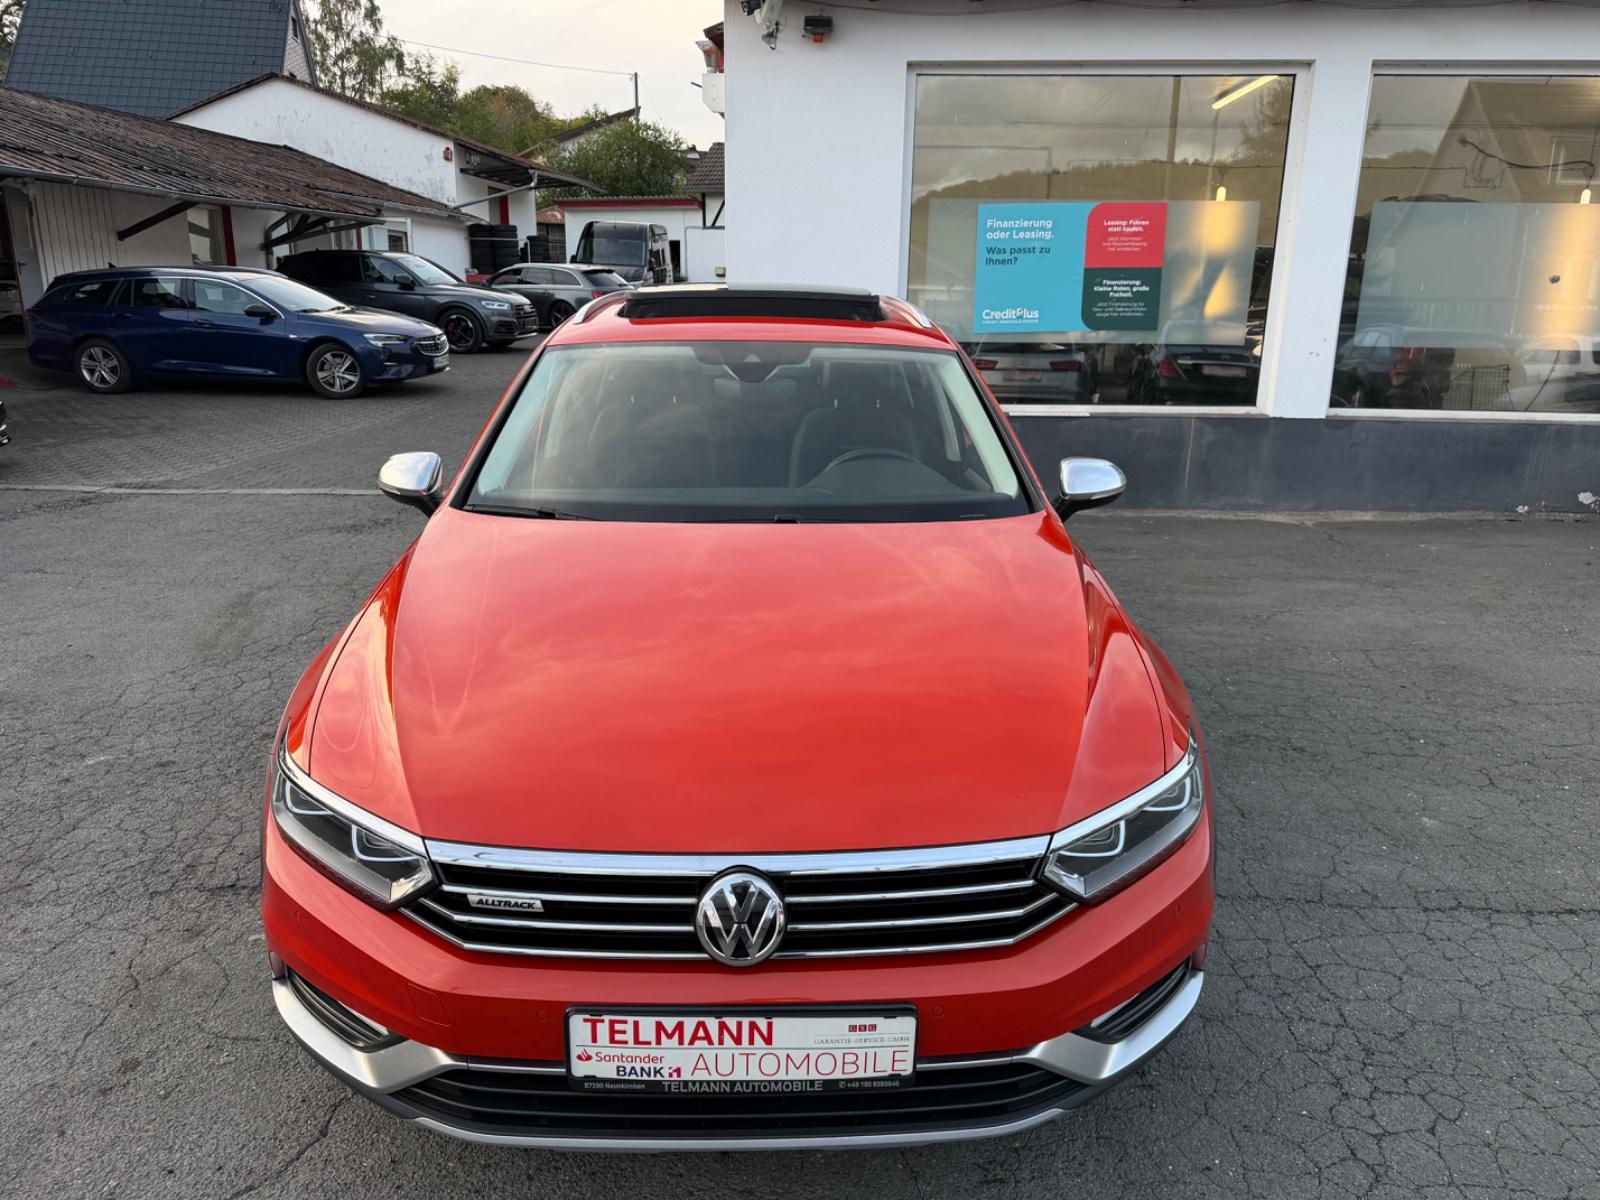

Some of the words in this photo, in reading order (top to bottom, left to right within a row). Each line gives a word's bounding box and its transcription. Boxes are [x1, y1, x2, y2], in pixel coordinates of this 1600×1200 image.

[986, 219, 1053, 229] Finanzierung
[986, 230, 1010, 239] oder
[1013, 230, 1054, 240] Leasing.
[986, 246, 1007, 255] Was
[1010, 246, 1036, 256] passt
[1039, 247, 1051, 255] zu
[985, 257, 1018, 266] Ihnen?
[982, 308, 1040, 320] CreditPlus
[476, 898, 536, 909] ALLTRACK
[582, 1018, 773, 1046] TELMANN
[595, 1051, 665, 1064] Santander
[690, 1050, 909, 1077] AUTOMOBILE
[662, 1081, 731, 1093] TELMANN
[733, 1081, 823, 1092] AUTOMOBILE
